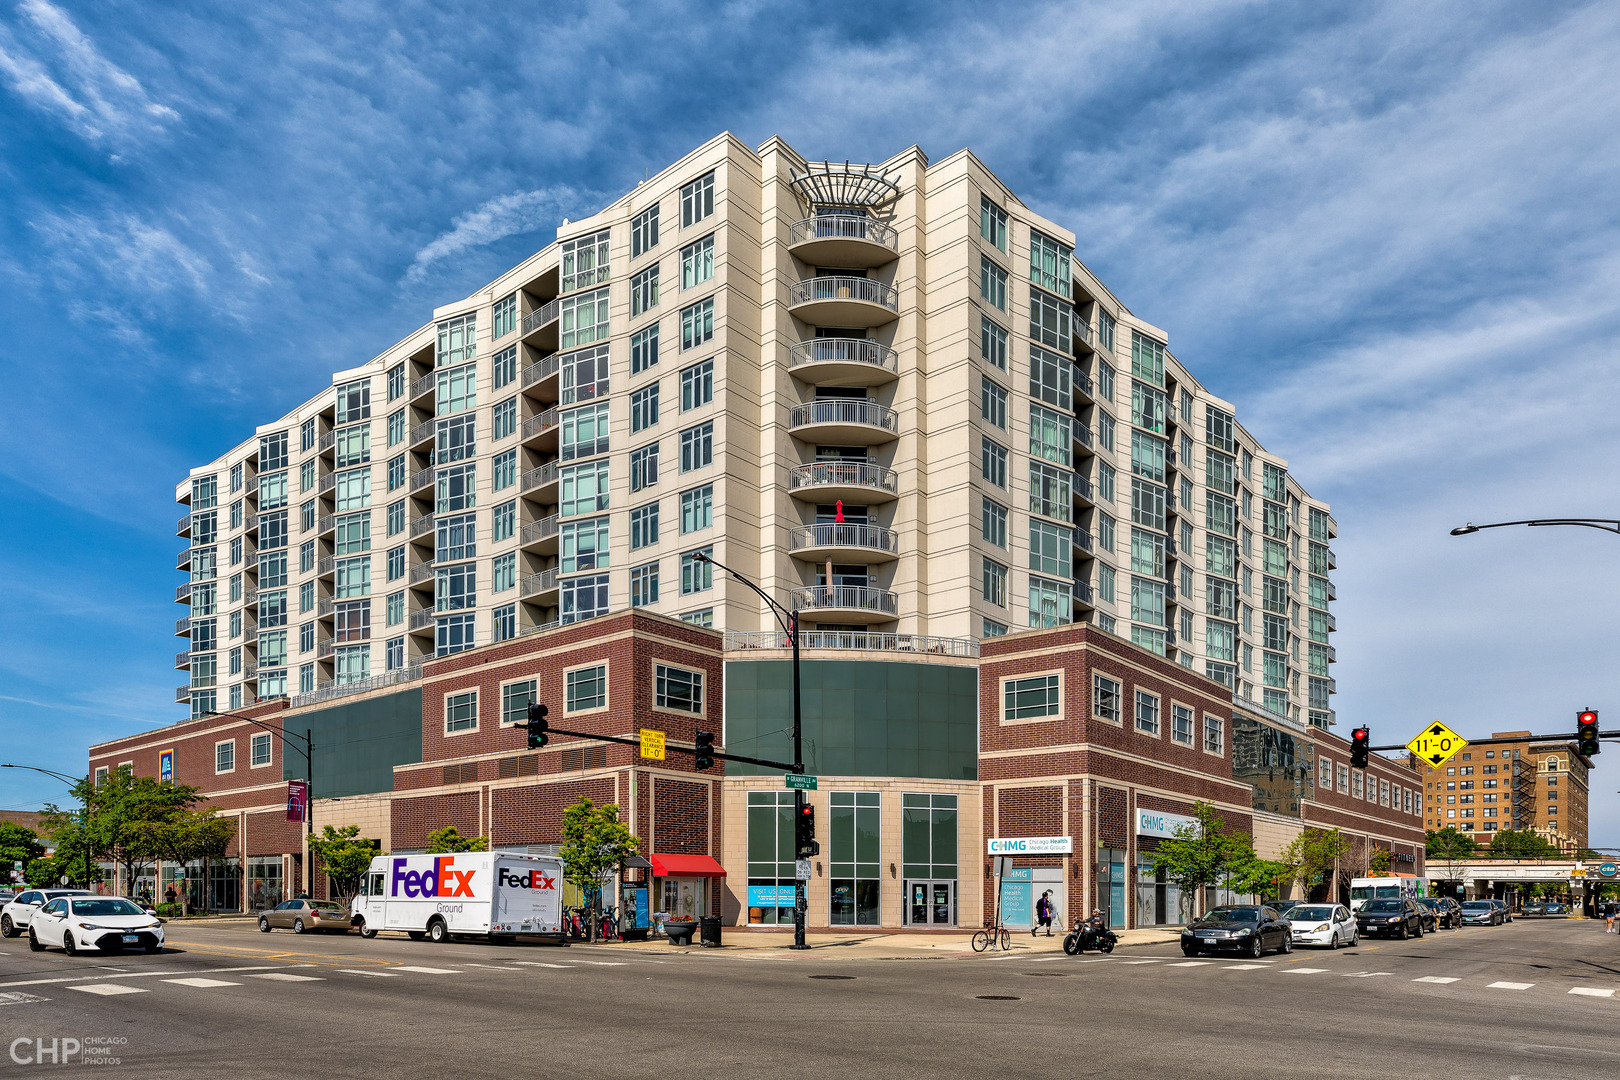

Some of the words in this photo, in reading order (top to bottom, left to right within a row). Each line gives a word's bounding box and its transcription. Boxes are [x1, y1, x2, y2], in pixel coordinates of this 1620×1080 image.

[1416, 737, 1459, 752] 11'-0"
[1141, 814, 1164, 831] CHMG
[391, 856, 476, 898] FedEx
[498, 868, 556, 890] FedEx
[437, 903, 463, 913] Ground
